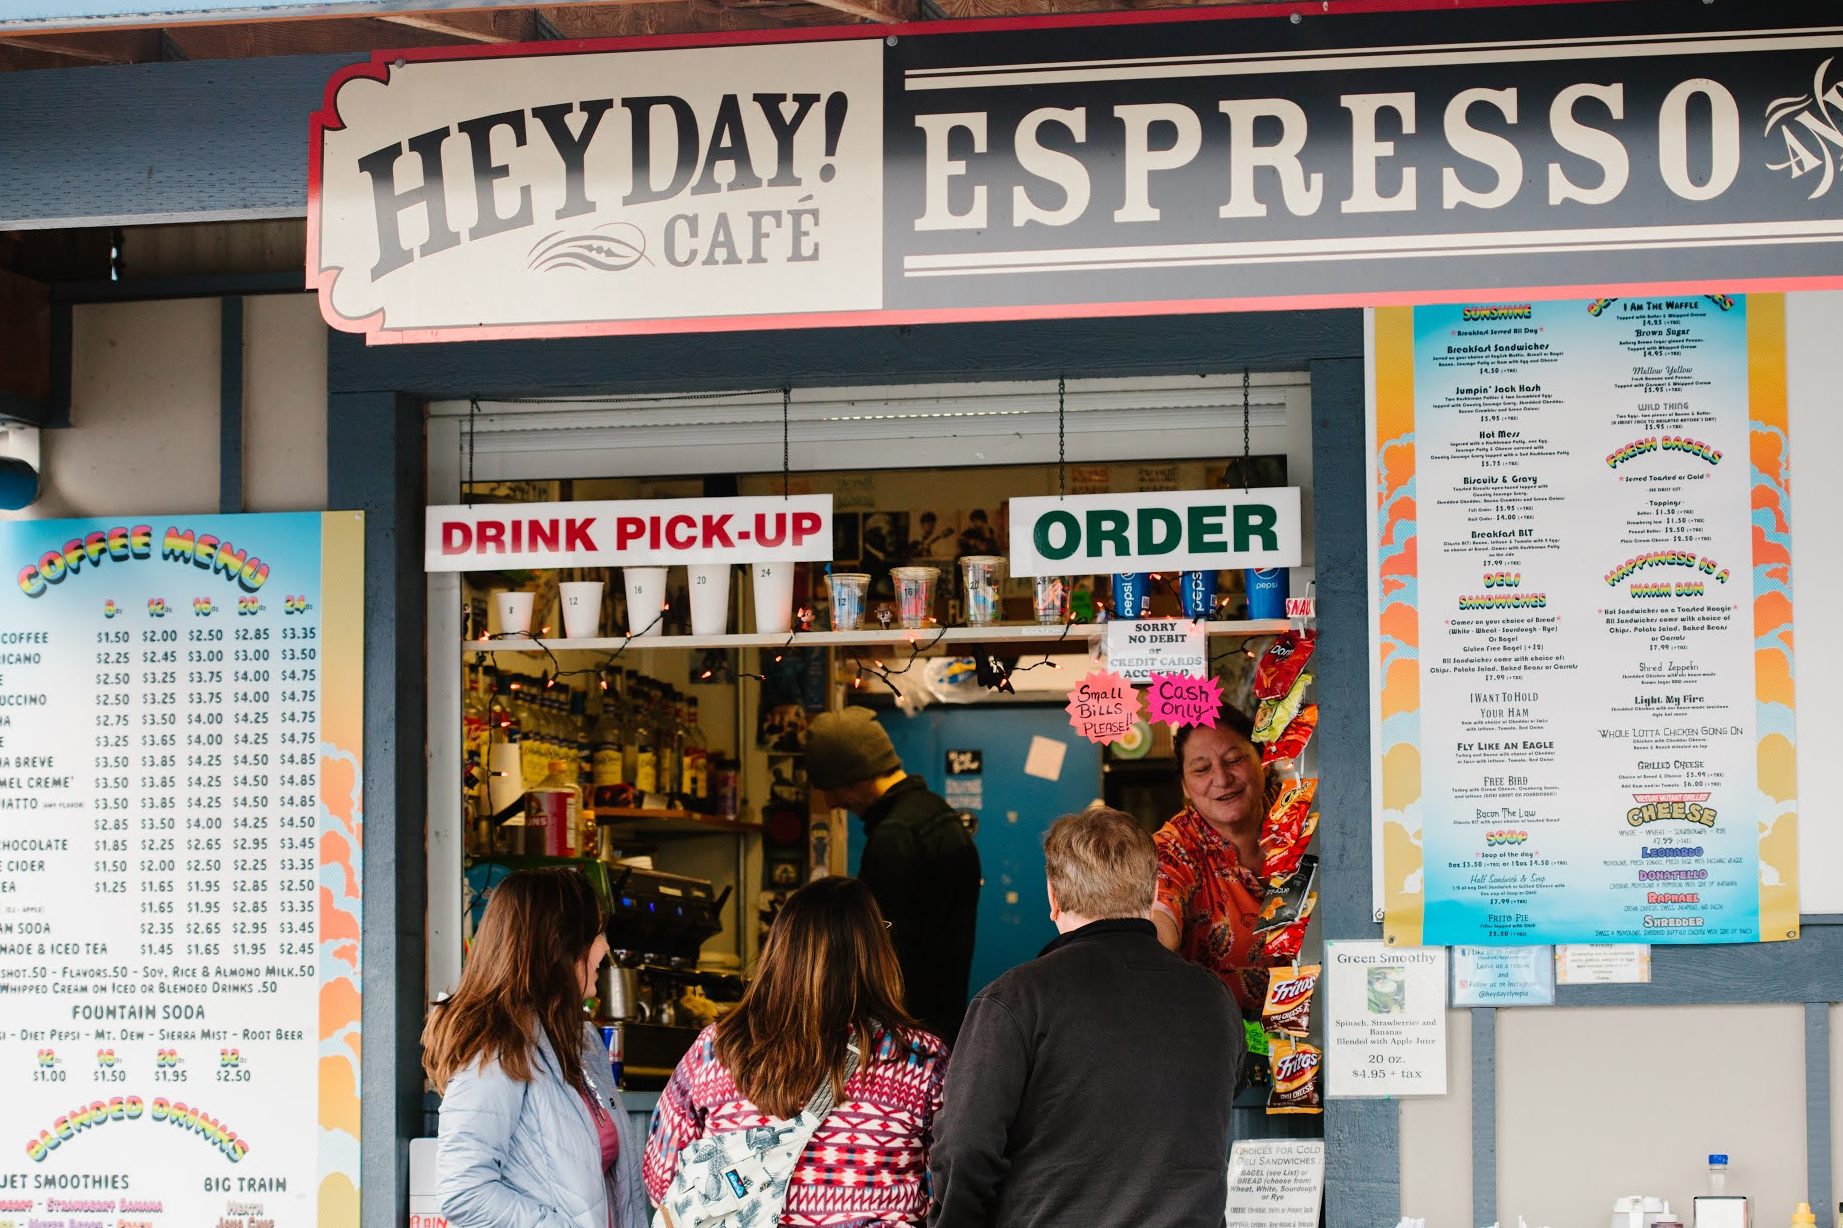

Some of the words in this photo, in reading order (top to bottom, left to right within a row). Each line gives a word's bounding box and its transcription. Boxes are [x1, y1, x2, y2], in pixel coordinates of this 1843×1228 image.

[914, 77, 1740, 233] ESPRESSO
[357, 90, 848, 285] HEYDAY!
[664, 195, 820, 268] CAFÉ
[1463, 304, 1531, 321] SUNSHINE
[1635, 329, 1662, 337] Brown
[1666, 328, 1690, 336] Sugar
[1448, 345, 1491, 353] Breakfast
[1494, 343, 1549, 352] Sandwiches
[1495, 385, 1516, 393] Jack
[1519, 384, 1540, 392] Hash
[1606, 436, 1657, 469] FRESH
[1662, 435, 1723, 465] BAGELS
[1464, 476, 1498, 484] Biscuits
[1512, 475, 1537, 484] Gravy
[441, 517, 598, 555] DRINK
[616, 511, 823, 551] PICK-UP
[1034, 504, 1278, 560] ORDER
[1472, 530, 1515, 538] Breakfast
[17, 524, 152, 599] COFFEE
[162, 526, 271, 593] MENU
[760, 568, 771, 578] 24
[1604, 550, 1696, 587] HAPPINESS
[1699, 557, 1717, 575] IS
[696, 576, 706, 585] 20
[1256, 581, 1278, 590] pepsi
[1483, 572, 1521, 588] DELI
[634, 585, 643, 595] 16
[904, 588, 913, 597] 16
[1192, 571, 1205, 612] peps
[1630, 582, 1671, 598] WARM
[1675, 581, 1704, 597] GUN
[569, 597, 578, 606] 12
[838, 597, 846, 606] 12
[1124, 581, 1134, 617] pepsi
[1459, 593, 1546, 610] SANDWICHES
[509, 606, 513, 615] 8
[1136, 623, 1177, 632] SORRY
[2, 632, 48, 644] COFFEE
[97, 632, 129, 643] $1.50
[143, 630, 177, 642] $2.00
[189, 629, 223, 641] $2.50
[235, 628, 269, 640] $2.85
[283, 627, 315, 639] $3.35
[1128, 635, 1147, 643] NO
[1150, 634, 1187, 643] DEBIT
[1111, 657, 1156, 667] CREDIT
[1160, 656, 1202, 666] CARDS
[1160, 681, 1209, 702] Cash
[1458, 743, 1473, 751] FLY
[1523, 741, 1553, 749] EAGLE
[16, 756, 53, 768] BREVE
[96, 756, 128, 768] $3.50
[142, 755, 175, 767] $3.85
[188, 755, 221, 766] $4.25
[234, 754, 268, 765] $4.50
[280, 753, 315, 765] $4.85
[1477, 809, 1499, 819] Bacon
[1502, 808, 1516, 818] The
[1519, 808, 1536, 818] Law
[1627, 802, 1717, 827] CHEESE
[1485, 830, 1528, 846] SOUP
[1642, 847, 1704, 858] LEONARDO
[1639, 869, 1708, 881] DONATELLO
[1648, 892, 1700, 904] RAPHAEL
[1643, 915, 1704, 927] SHREDDER
[1337, 954, 1375, 963] Green
[1380, 952, 1436, 964] Smoothy
[1271, 975, 1316, 1004] Fritos
[73, 1005, 156, 1019] FOUNTAIN
[163, 1005, 204, 1019] SODA
[1391, 1038, 1413, 1046] Apple
[1369, 1055, 1383, 1063] 20
[1277, 1053, 1319, 1081] Fritos
[1353, 1070, 1385, 1078] $4.95
[1402, 1070, 1421, 1078] tax
[26, 1095, 143, 1162] BLENDED
[151, 1097, 250, 1163] DRINKS
[34, 1174, 128, 1189] SMOOTHIES
[205, 1177, 230, 1192] BIG
[238, 1177, 286, 1192] TRAIN
[1280, 1185, 1317, 1193] Sourdough
